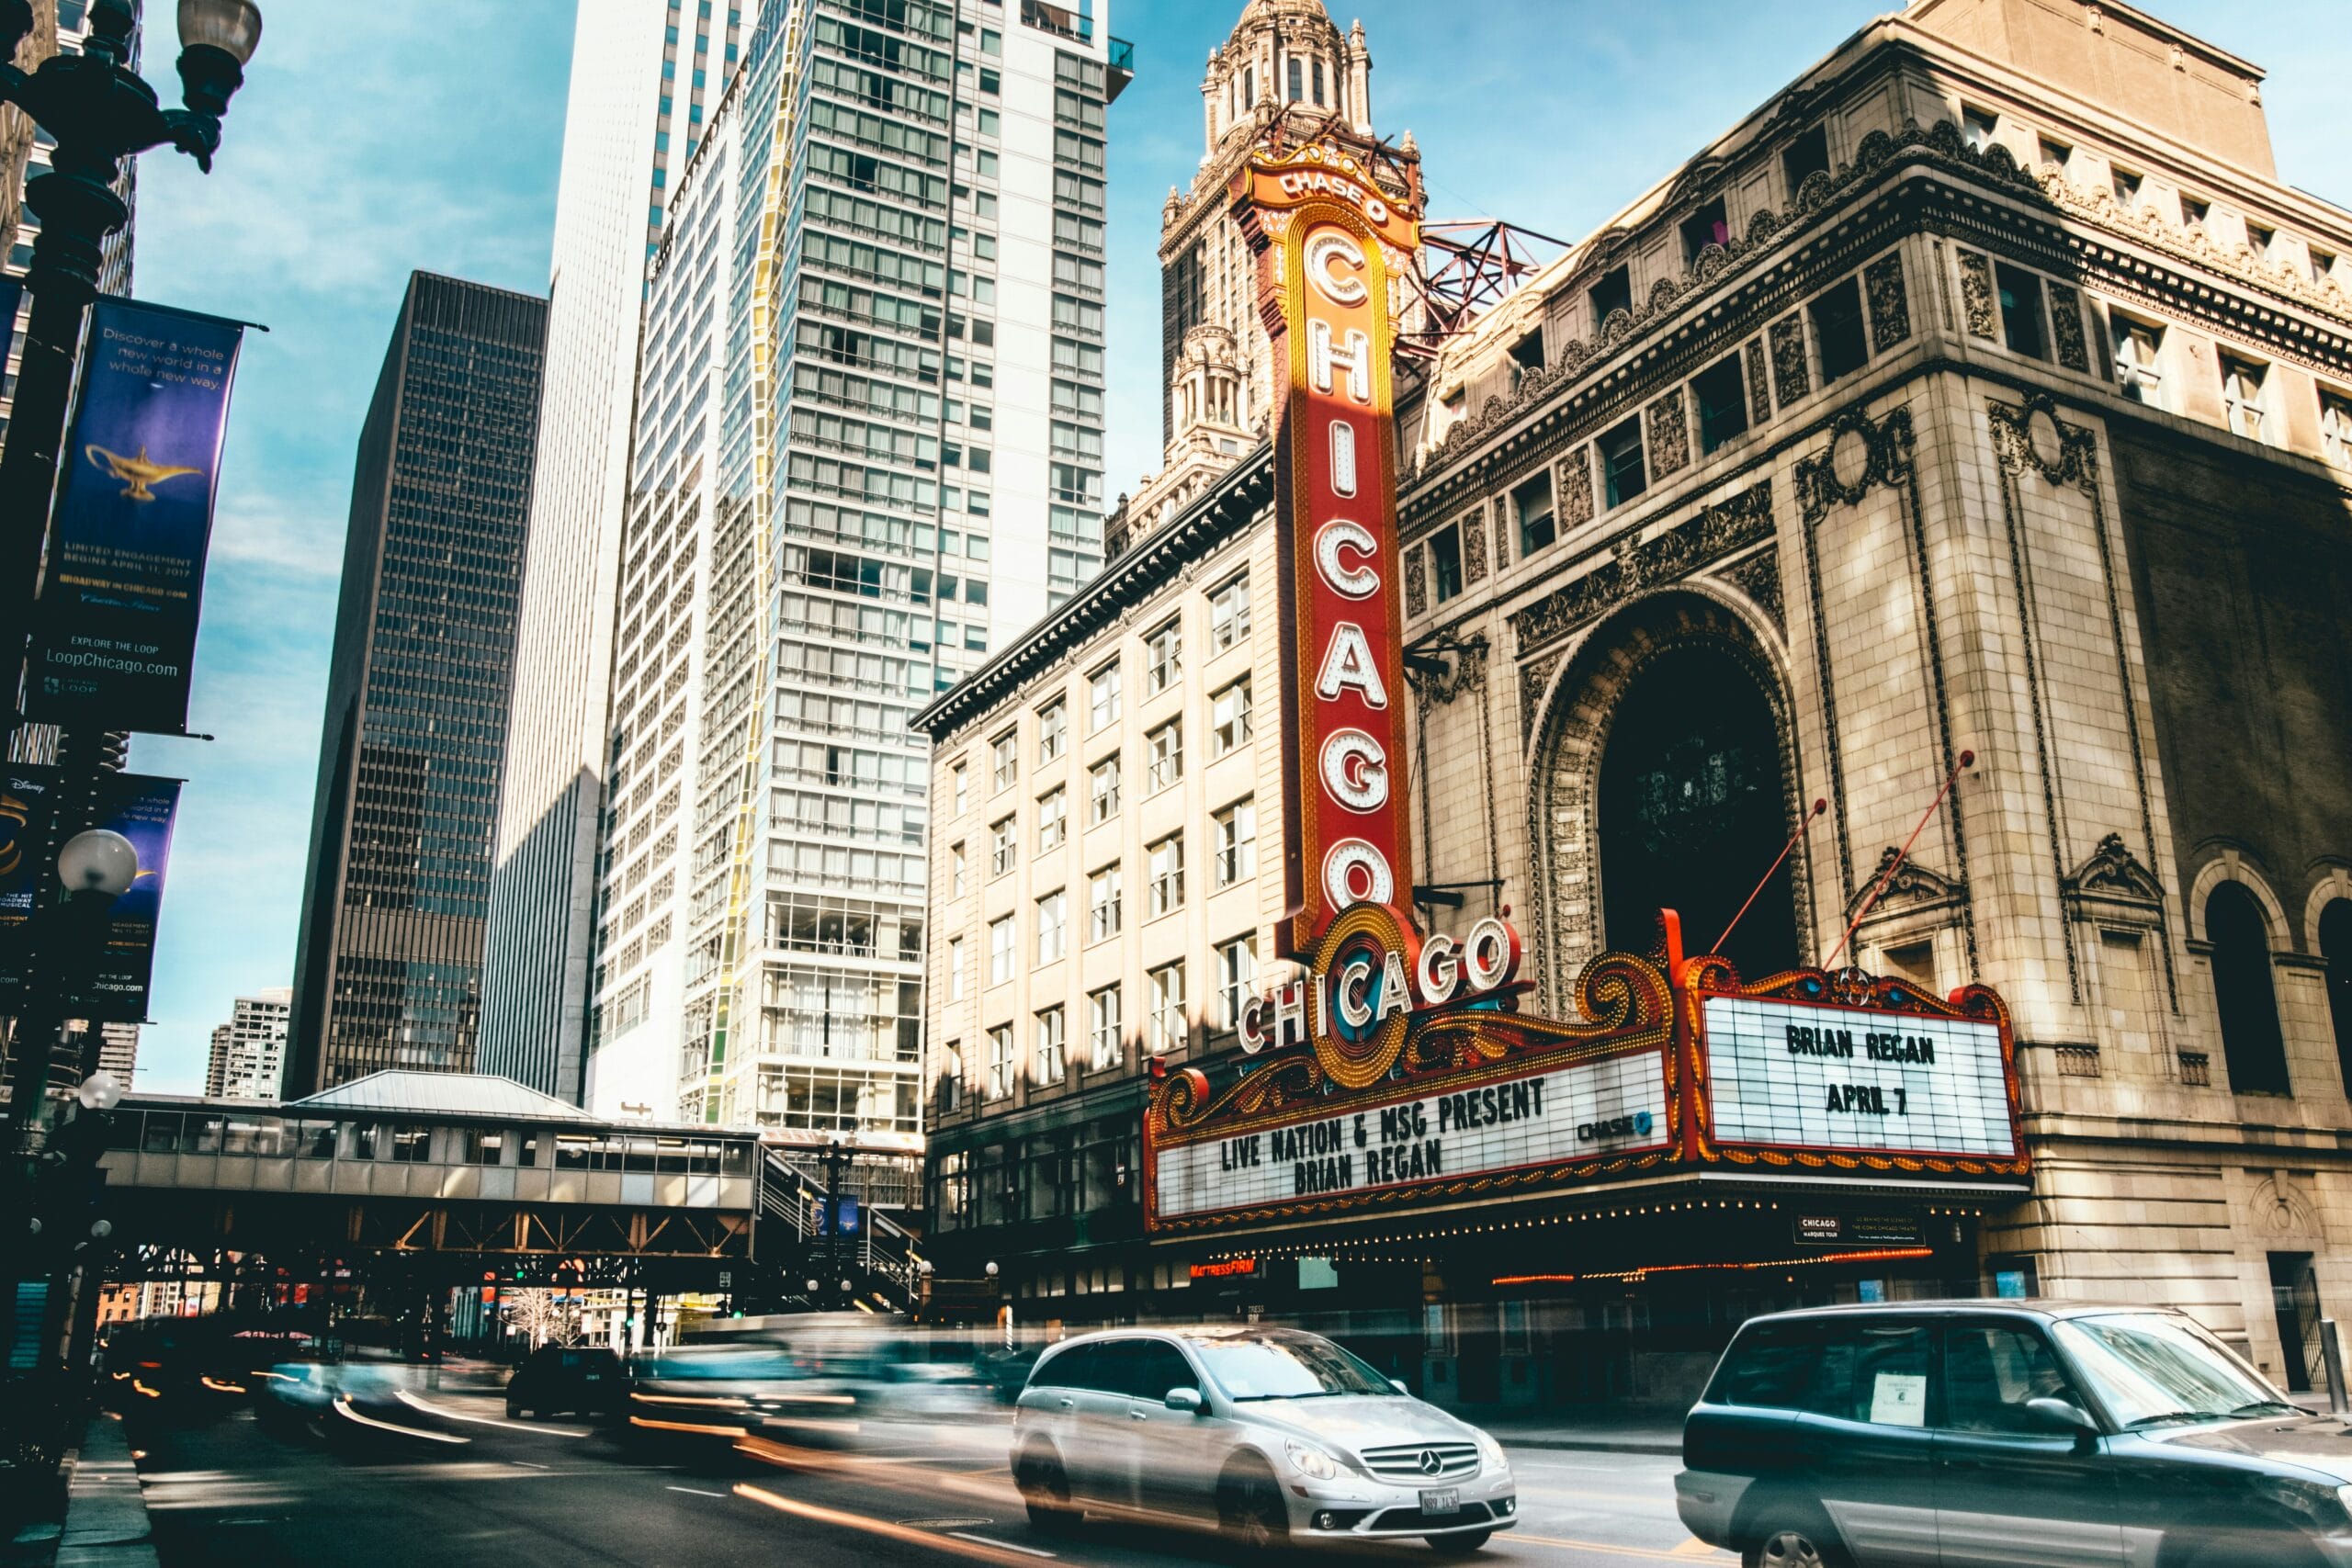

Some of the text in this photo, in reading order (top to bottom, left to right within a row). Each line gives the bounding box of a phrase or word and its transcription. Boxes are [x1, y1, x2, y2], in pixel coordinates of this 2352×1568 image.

[1279, 170, 1363, 205] CHASE
[103, 327, 224, 360] Discover a whole
[109, 361, 220, 390] whole new way.
[119, 348, 221, 375] new world in a
[63, 552, 107, 567] BEGINS
[165, 567, 190, 579] 2017
[65, 541, 192, 568] LIMITED ENGAGEMENT
[59, 573, 111, 589] BROADWAY
[1303, 232, 1394, 914] CHICAGO
[71, 636, 159, 655] EXPLORE THE LOOP
[47, 649, 178, 677] LoopChicago.com
[1238, 918, 1512, 1055] CHICAGO
[1786, 1024, 1936, 1066] BRIAN REGAN
[1826, 1083, 1907, 1116] APRIL 7
[1221, 1077, 1545, 1171] LIVE NATION & MSG PRESENT
[1577, 1115, 1635, 1141] CHASE
[1294, 1139, 1442, 1194] BRIAN REGAN
[1802, 1218, 1837, 1228] CHICAGO
